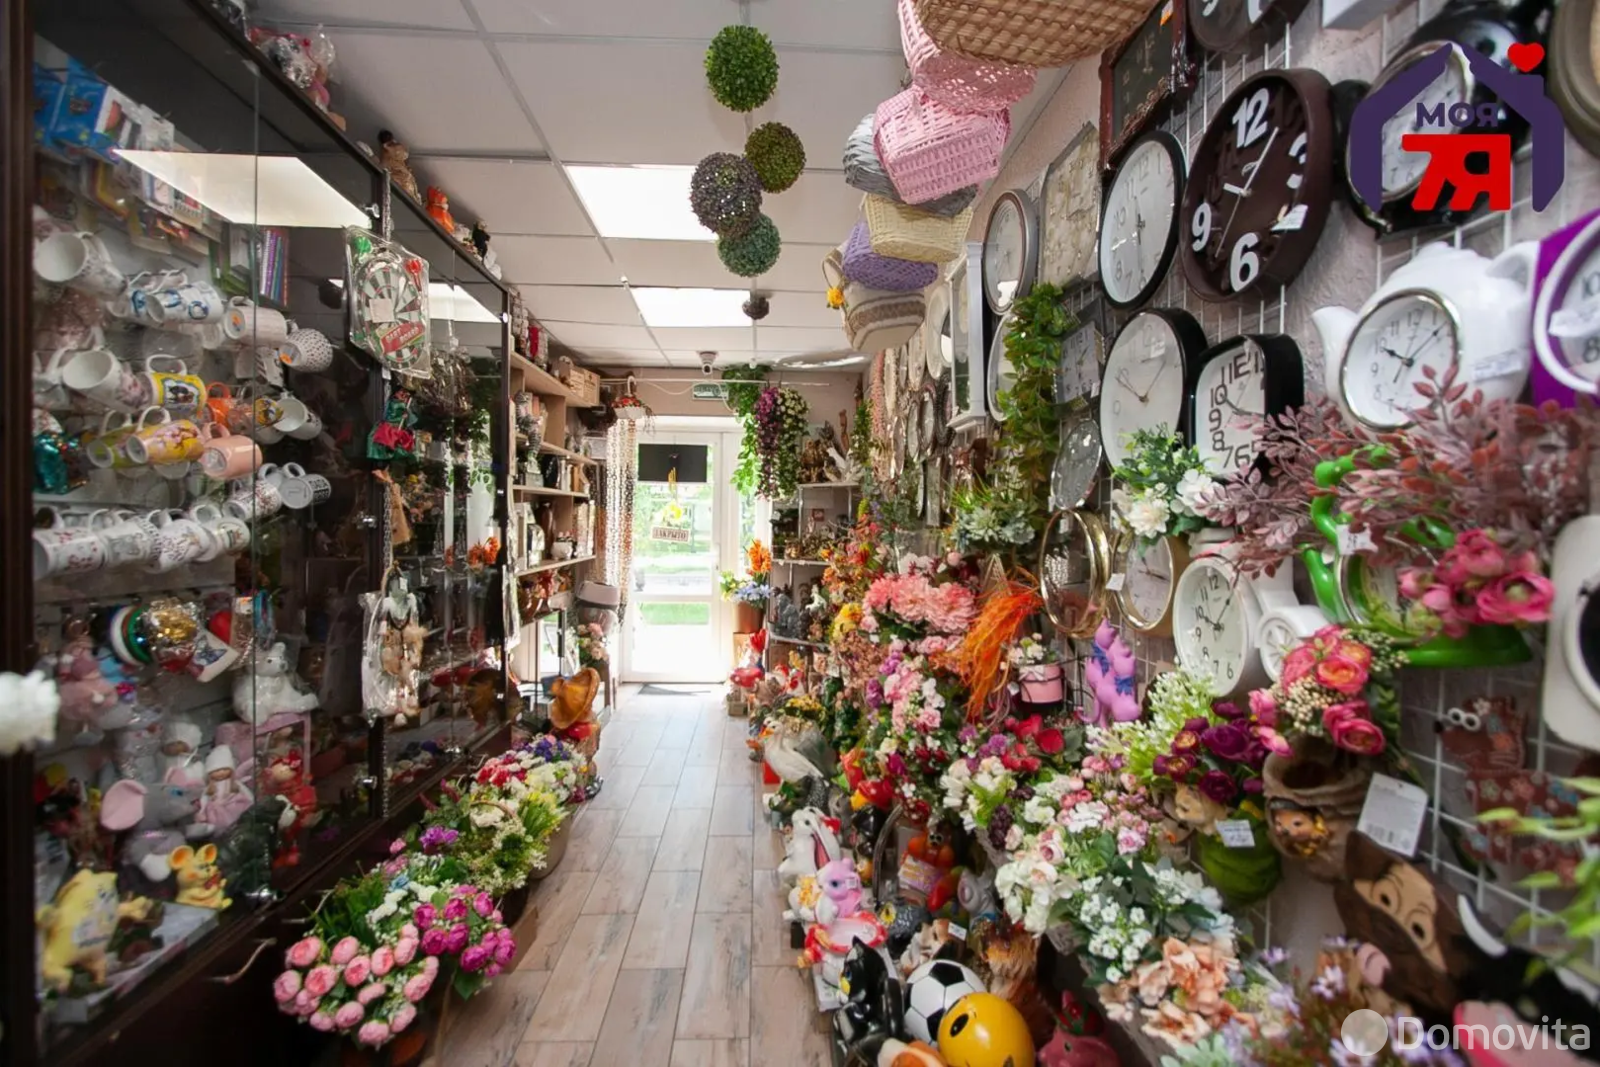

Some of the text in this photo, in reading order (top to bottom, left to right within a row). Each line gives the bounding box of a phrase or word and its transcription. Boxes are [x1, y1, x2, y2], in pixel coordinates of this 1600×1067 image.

[1232, 87, 1270, 148] 12
[1191, 202, 1212, 252] 9
[1230, 231, 1260, 293] 6
[1210, 384, 1229, 408] 10
[1208, 409, 1223, 433] 9
[1212, 430, 1226, 452] 8
[1208, 574, 1220, 591] 12
[1226, 662, 1235, 680] 6
